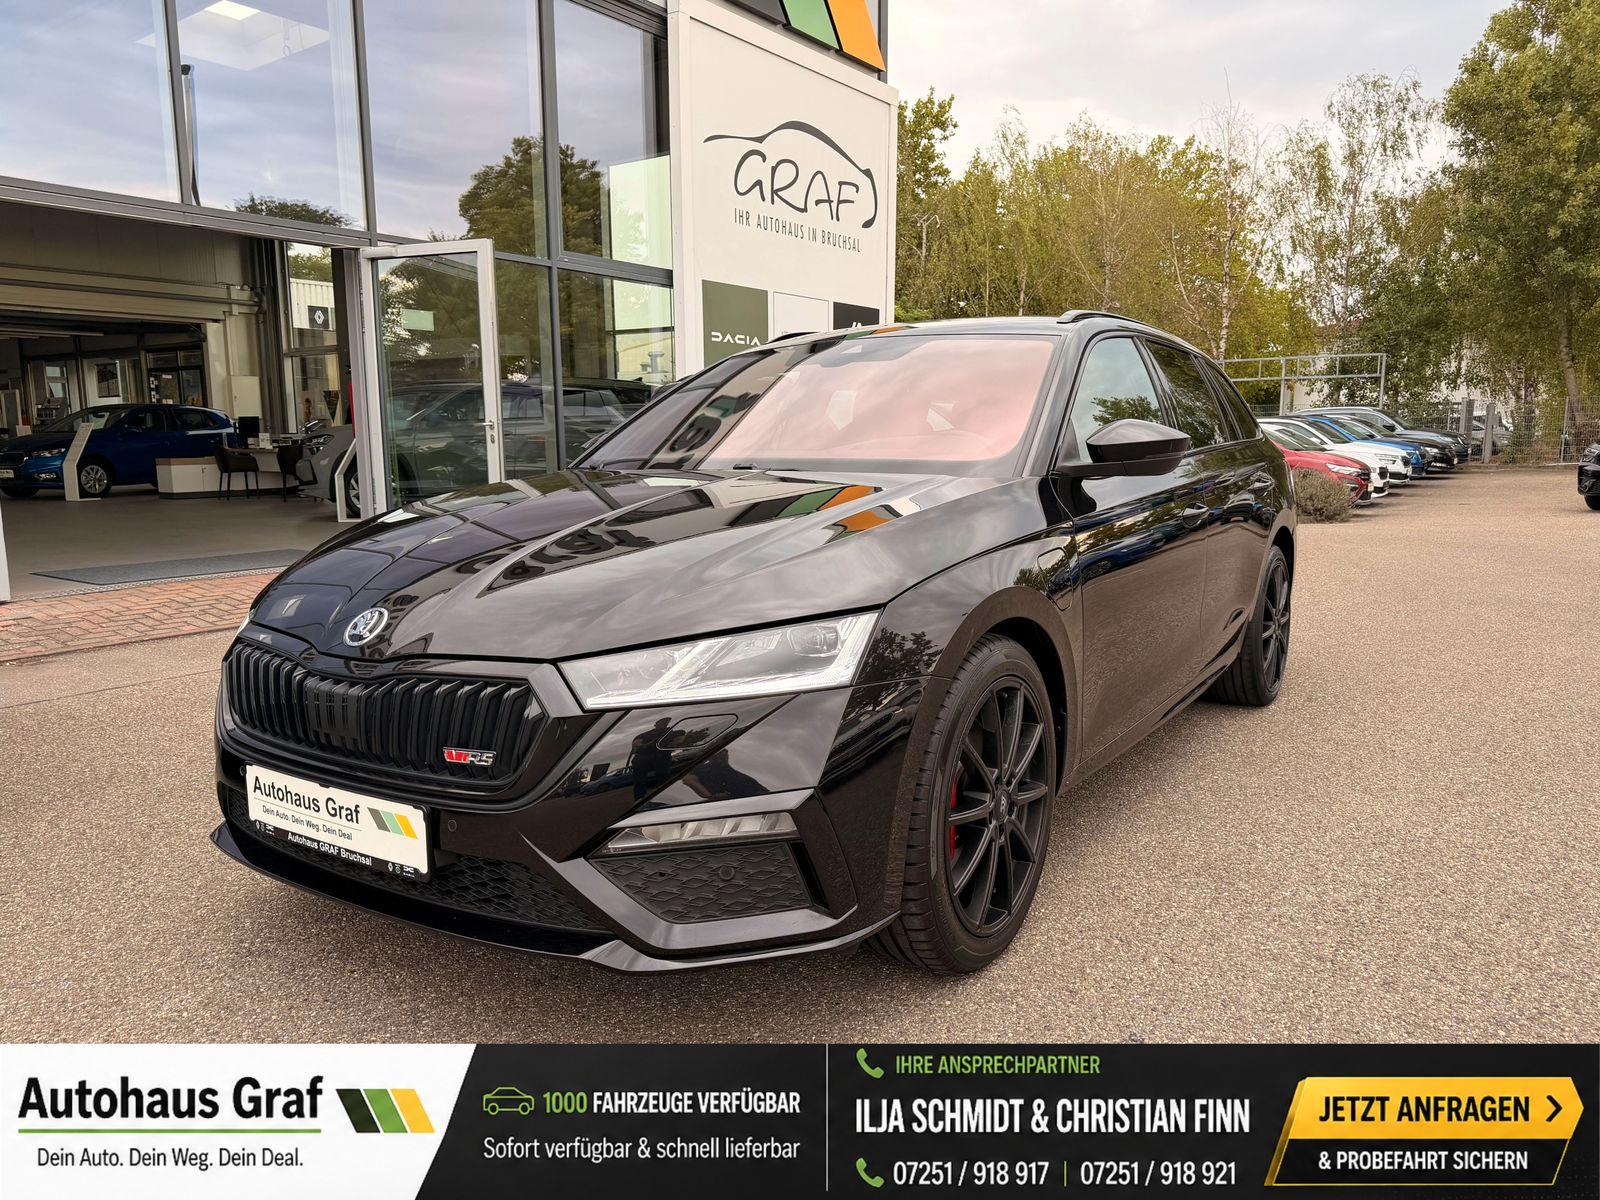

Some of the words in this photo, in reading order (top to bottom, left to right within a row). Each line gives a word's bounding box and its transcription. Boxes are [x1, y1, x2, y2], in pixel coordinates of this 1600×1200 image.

[734, 149, 859, 222] GRAF
[734, 207, 750, 227] IHR
[756, 214, 804, 240] AUTOHAUS
[808, 226, 817, 243] IN
[821, 230, 861, 253] BRUCHSAL
[711, 331, 761, 346] DACIA
[253, 775, 320, 813] Autohaus
[325, 797, 360, 825] Graf
[262, 804, 274, 815] Dein
[275, 808, 291, 821] Auto.
[291, 813, 305, 825] Dein
[305, 817, 321, 832] Weg.
[322, 824, 337, 836] Dein
[338, 829, 353, 841] Deal
[287, 832, 318, 850] Autohaus
[319, 841, 339, 856] GRAF
[340, 848, 372, 866] Bruchsal
